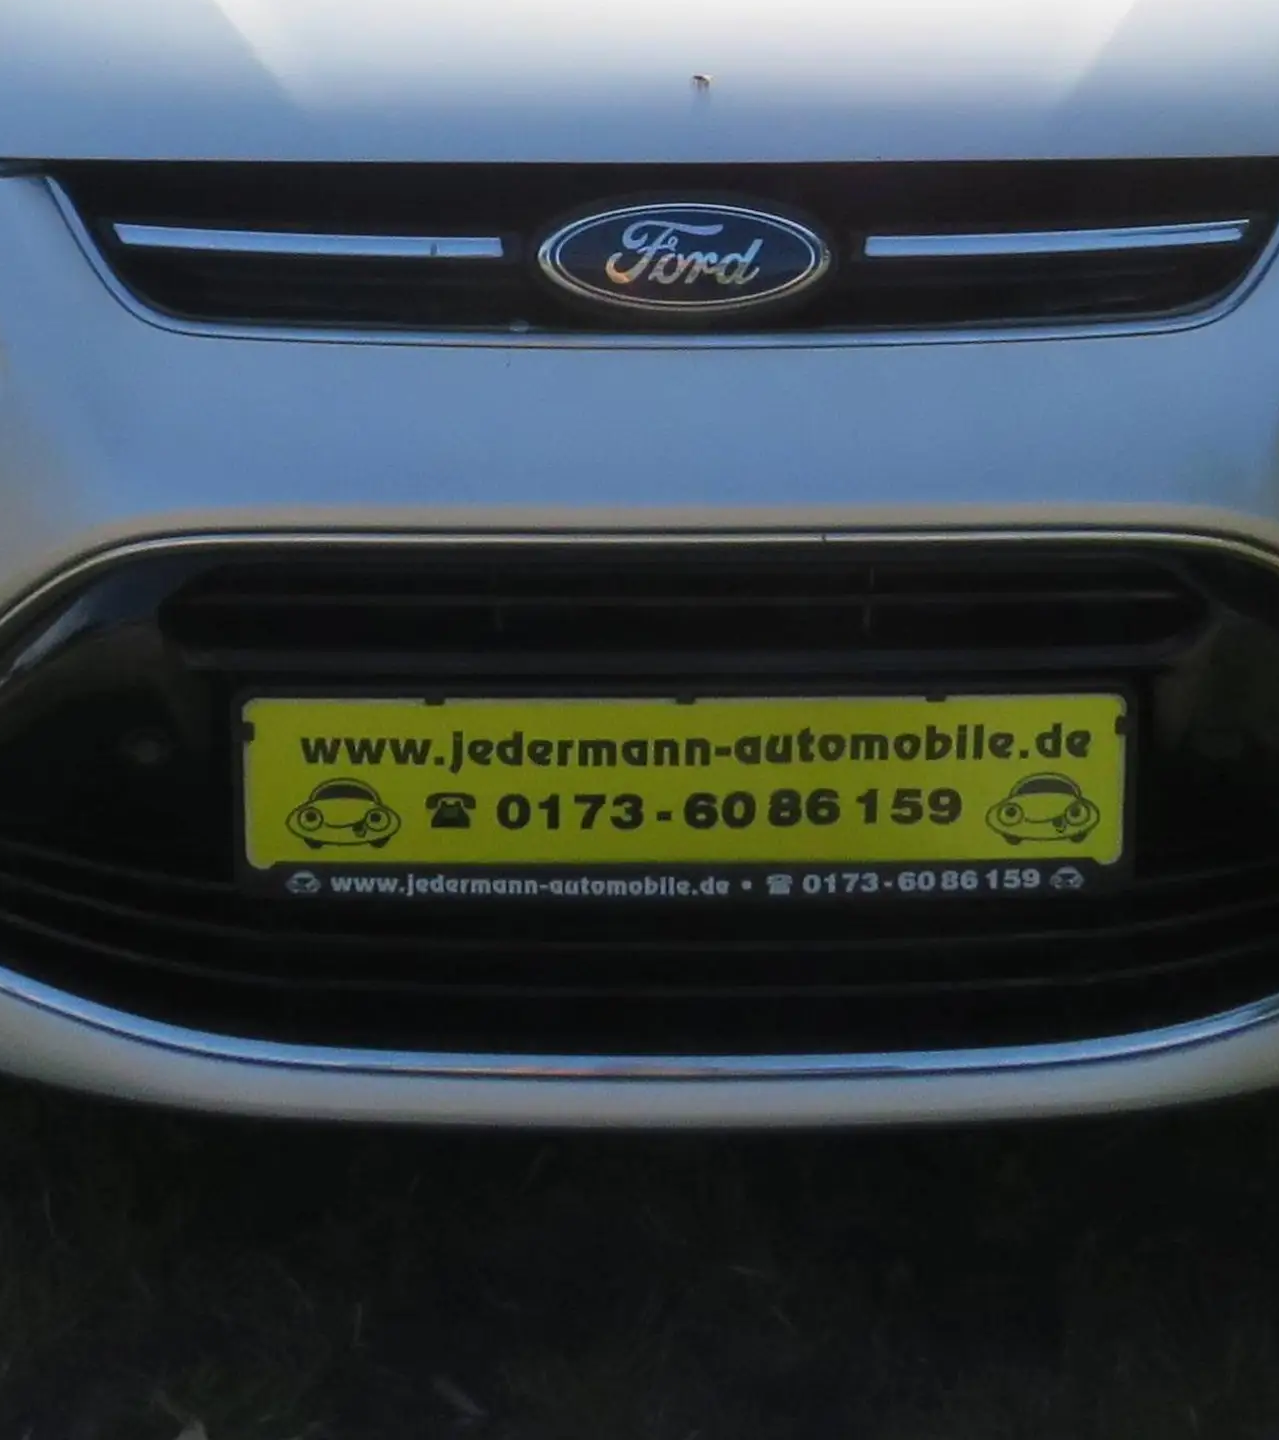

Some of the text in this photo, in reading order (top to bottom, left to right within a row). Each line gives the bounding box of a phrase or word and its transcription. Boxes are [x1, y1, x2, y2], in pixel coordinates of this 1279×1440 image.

[605, 219, 764, 285] Ford
[300, 723, 1092, 775] www.jedermann-automobile.de
[329, 873, 730, 896] www.jedermann-automobile.de
